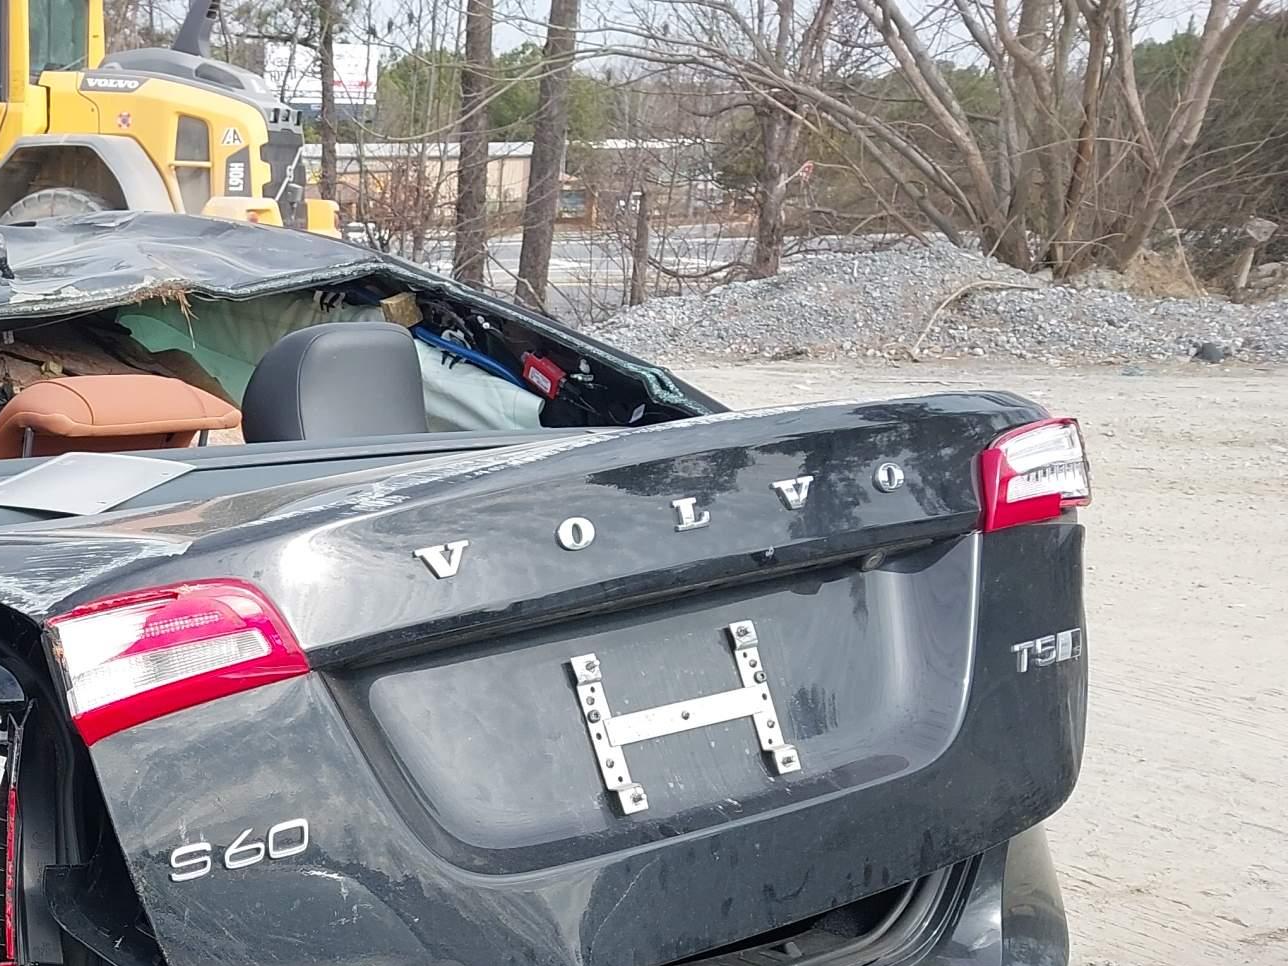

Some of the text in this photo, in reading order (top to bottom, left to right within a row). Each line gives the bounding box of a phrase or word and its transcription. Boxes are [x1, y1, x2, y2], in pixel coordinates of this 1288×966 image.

[86, 78, 139, 89] VOLVO
[228, 162, 244, 192] L90H
[170, 817, 309, 882] S60
